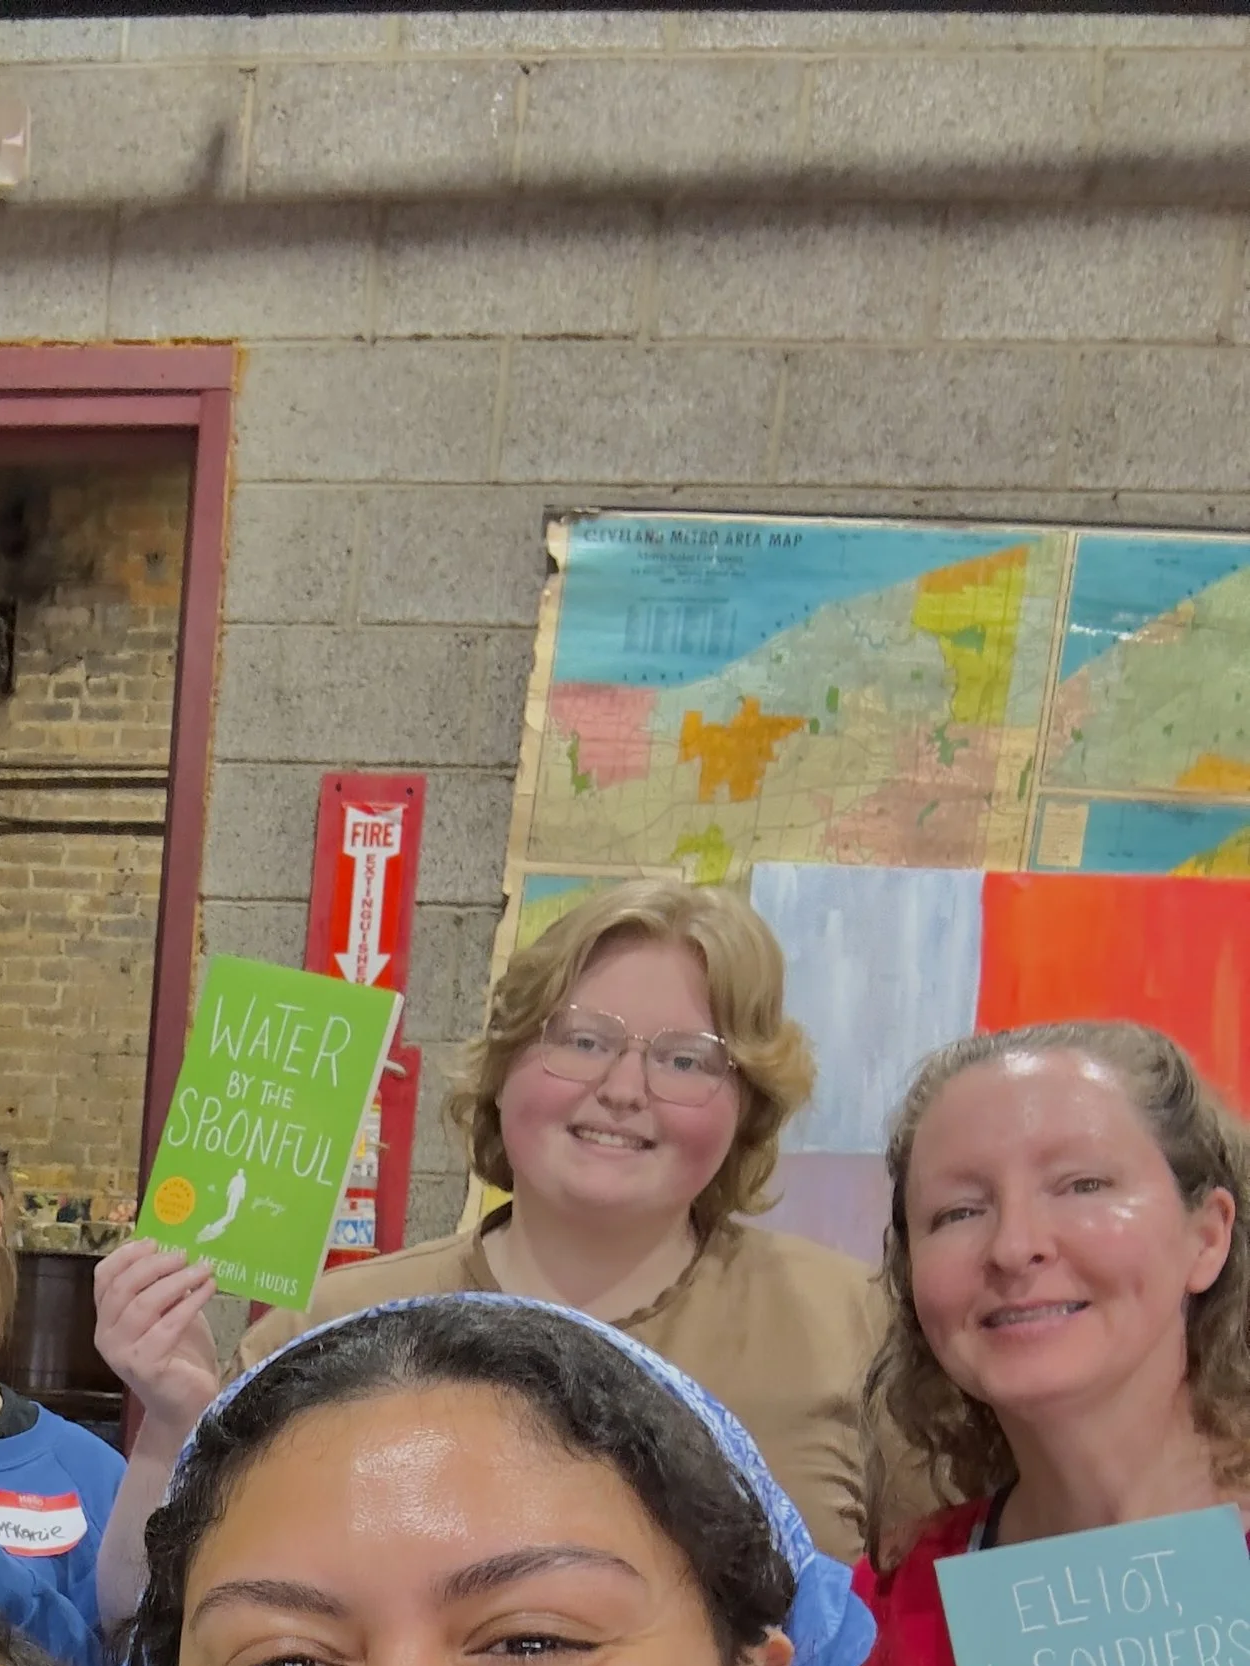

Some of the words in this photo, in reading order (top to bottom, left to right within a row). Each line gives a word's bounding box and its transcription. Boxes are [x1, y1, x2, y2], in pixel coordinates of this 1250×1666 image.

[670, 529, 719, 546] METRO
[724, 531, 761, 548] AREA
[768, 533, 804, 549] MAP
[350, 821, 395, 848] FIRE
[354, 854, 376, 985] EXTINGUISHER
[208, 994, 352, 1088] WATER
[227, 1070, 256, 1101] BY
[261, 1080, 295, 1110] THE
[166, 1086, 335, 1187] SPOONFUL
[1011, 1549, 1185, 1634] ELLIOT,
